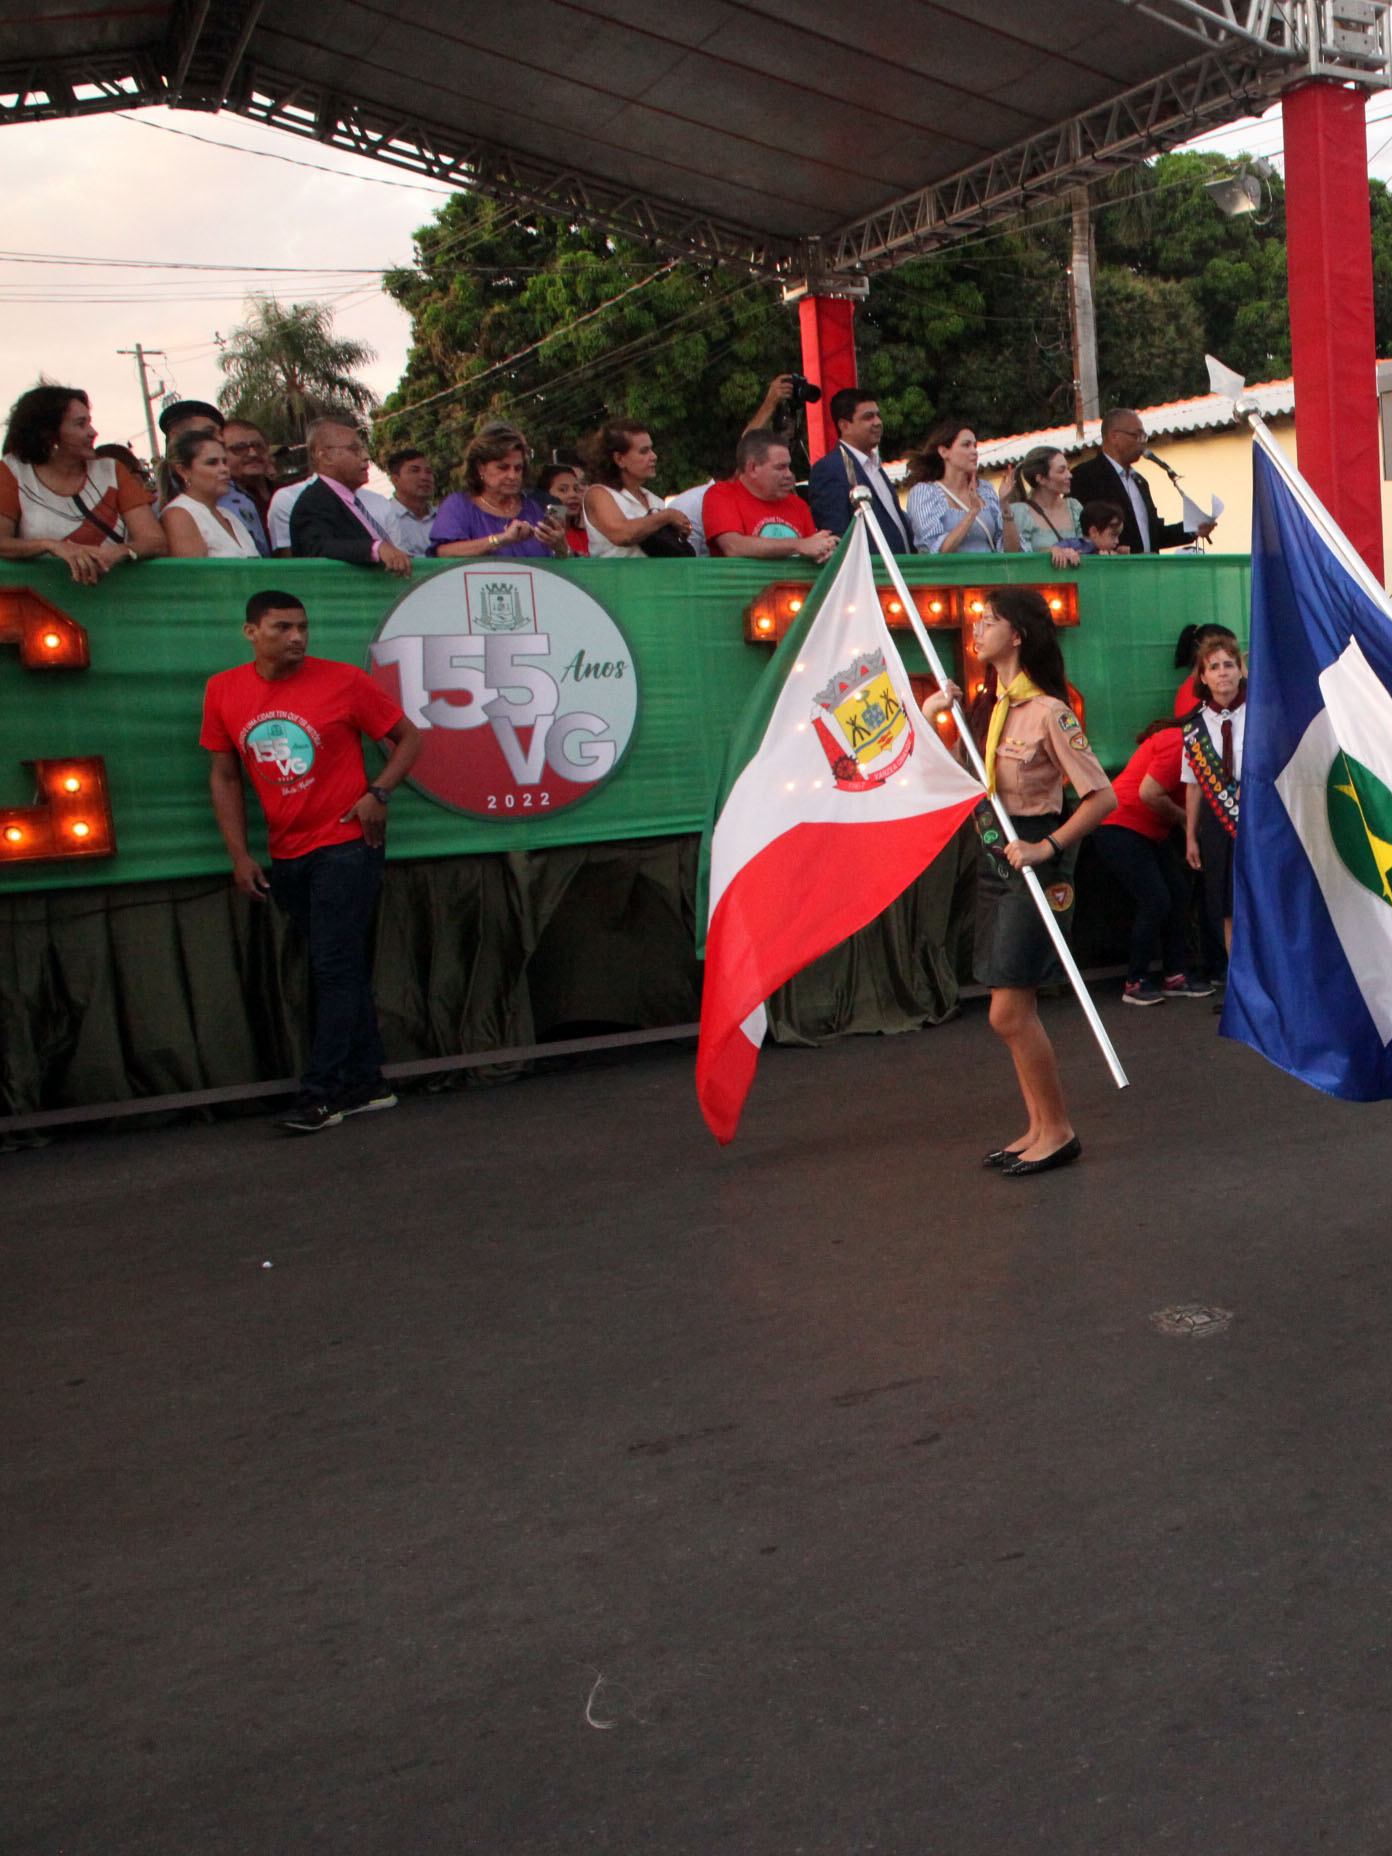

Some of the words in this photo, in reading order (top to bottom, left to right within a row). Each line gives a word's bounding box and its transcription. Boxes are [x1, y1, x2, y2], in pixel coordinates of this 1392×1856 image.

[371, 633, 560, 730] 155
[560, 649, 629, 684] Anos
[248, 737, 291, 763] 155
[490, 711, 617, 786] VG
[276, 757, 308, 776] VG
[487, 793, 550, 809] 2022
